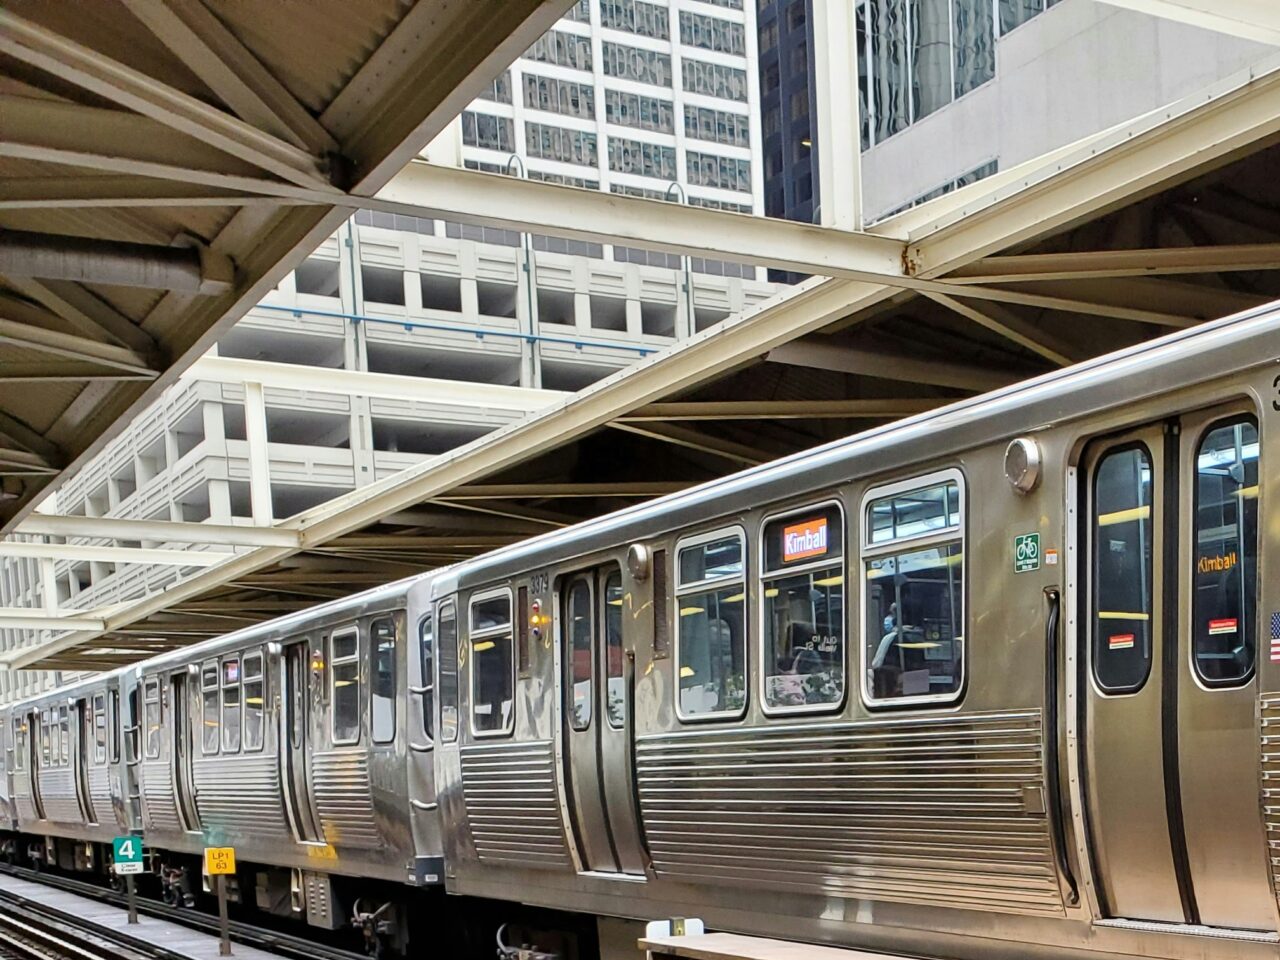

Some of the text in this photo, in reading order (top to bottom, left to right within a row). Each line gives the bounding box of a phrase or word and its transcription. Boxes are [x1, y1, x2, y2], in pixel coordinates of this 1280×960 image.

[784, 525, 827, 555] Kimball
[1197, 552, 1237, 573] Kimball
[531, 572, 549, 594] 3379
[119, 840, 135, 859] 4
